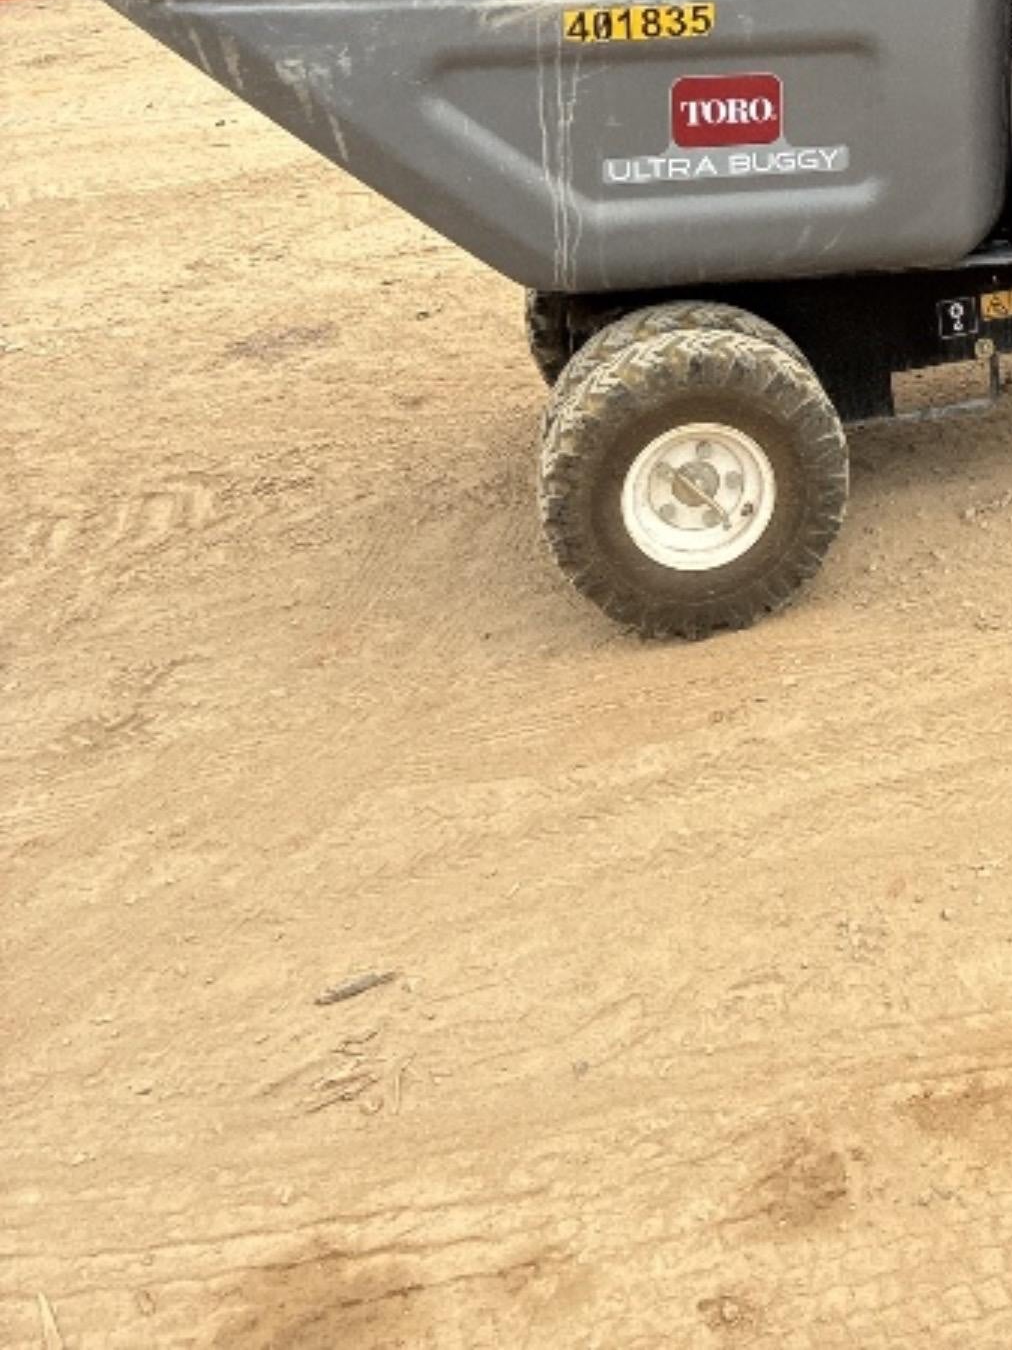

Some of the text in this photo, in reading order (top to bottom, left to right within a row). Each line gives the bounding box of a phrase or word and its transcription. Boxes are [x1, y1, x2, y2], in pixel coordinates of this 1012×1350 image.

[566, 4, 713, 41] 401835
[680, 95, 774, 127] TORO
[607, 149, 839, 182] ULTRA BUGGY
